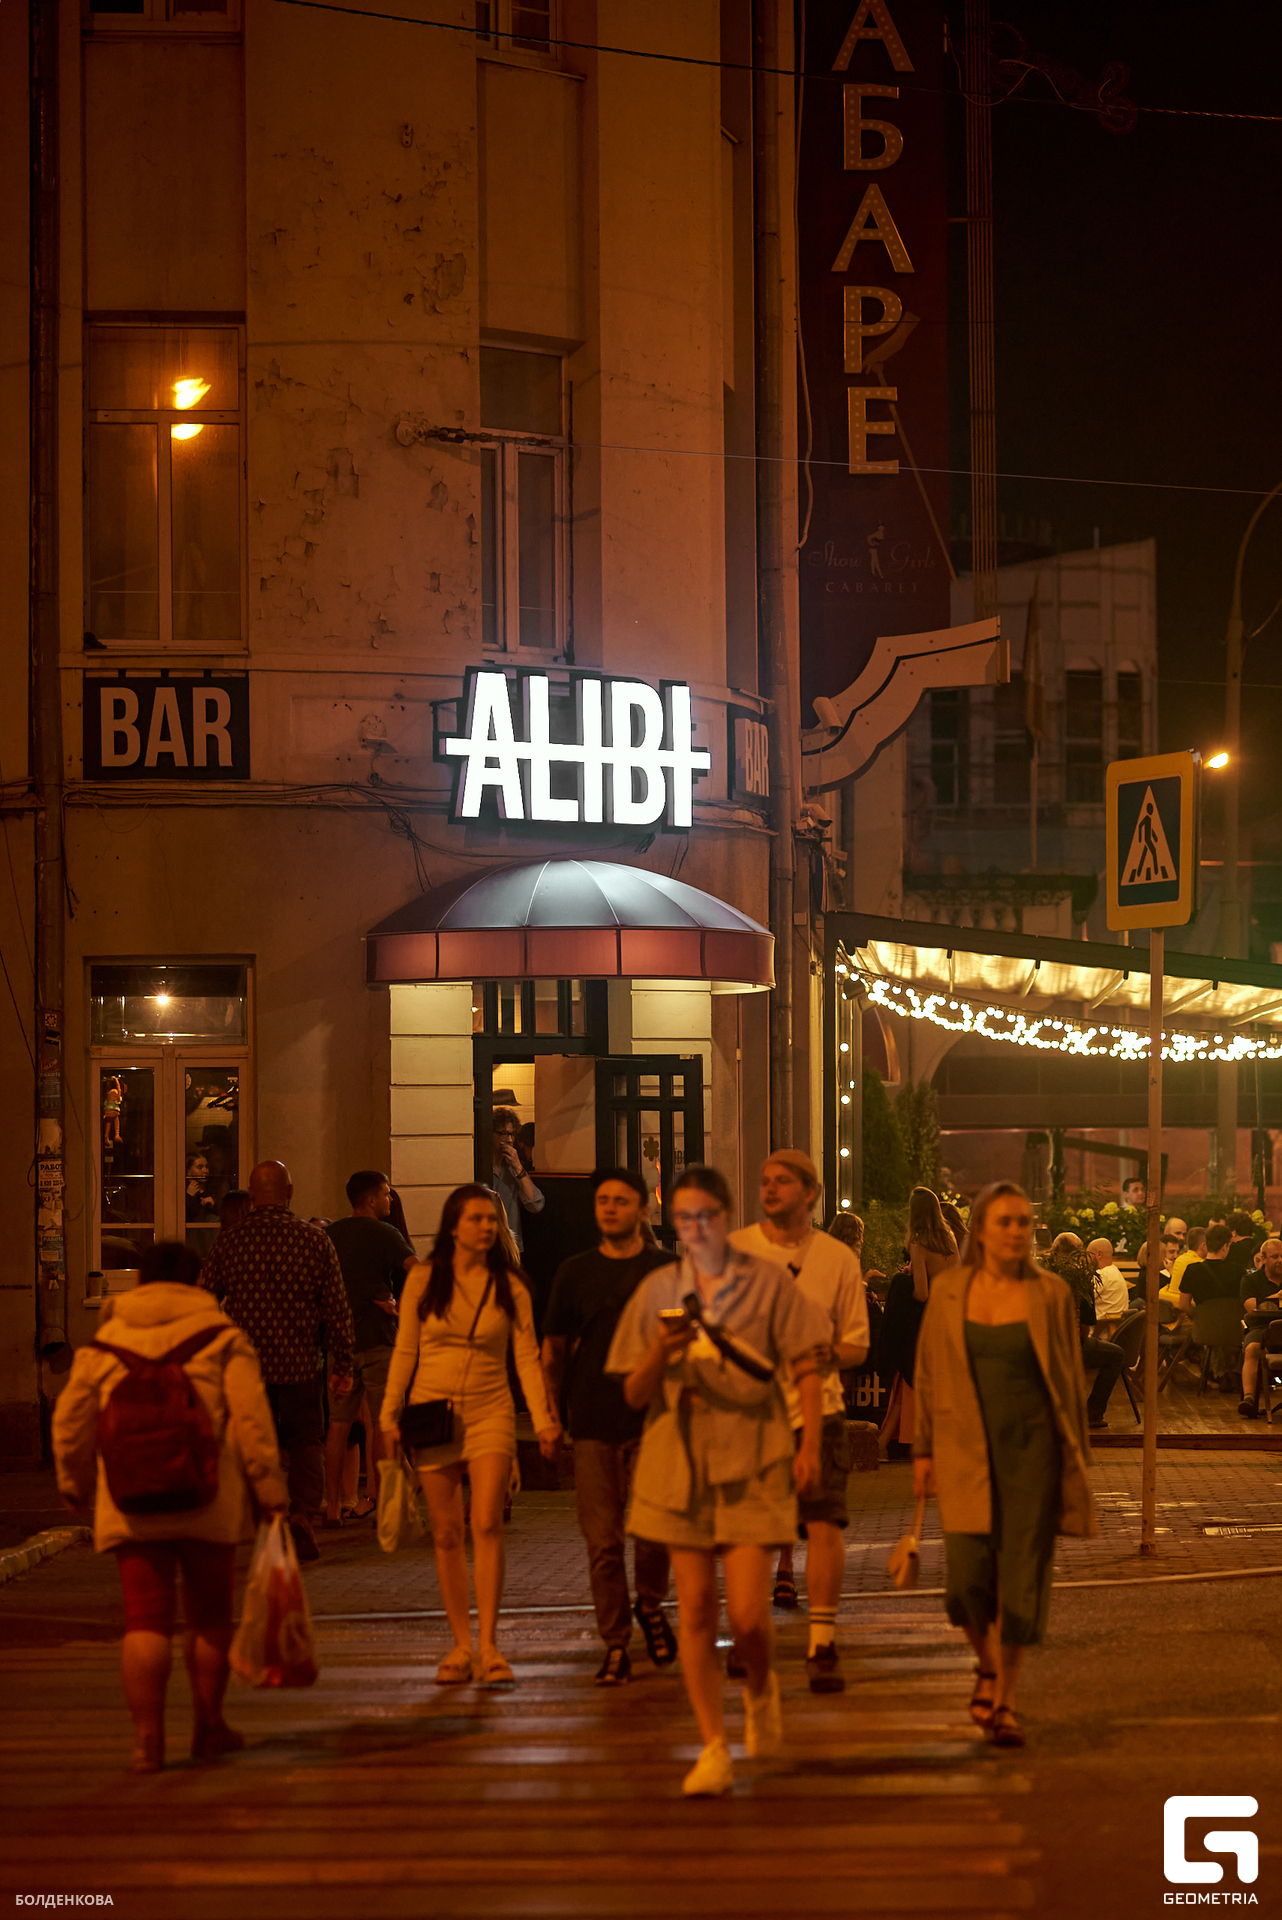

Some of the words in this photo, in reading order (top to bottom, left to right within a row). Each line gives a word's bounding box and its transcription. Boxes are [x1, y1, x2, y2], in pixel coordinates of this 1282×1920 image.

[808, 540, 863, 568] Show
[888, 541, 937, 572] Girls
[825, 581, 920, 593] CABARET
[100, 686, 234, 768] BAR
[446, 672, 711, 828] ALIBI
[744, 717, 770, 798] BAR
